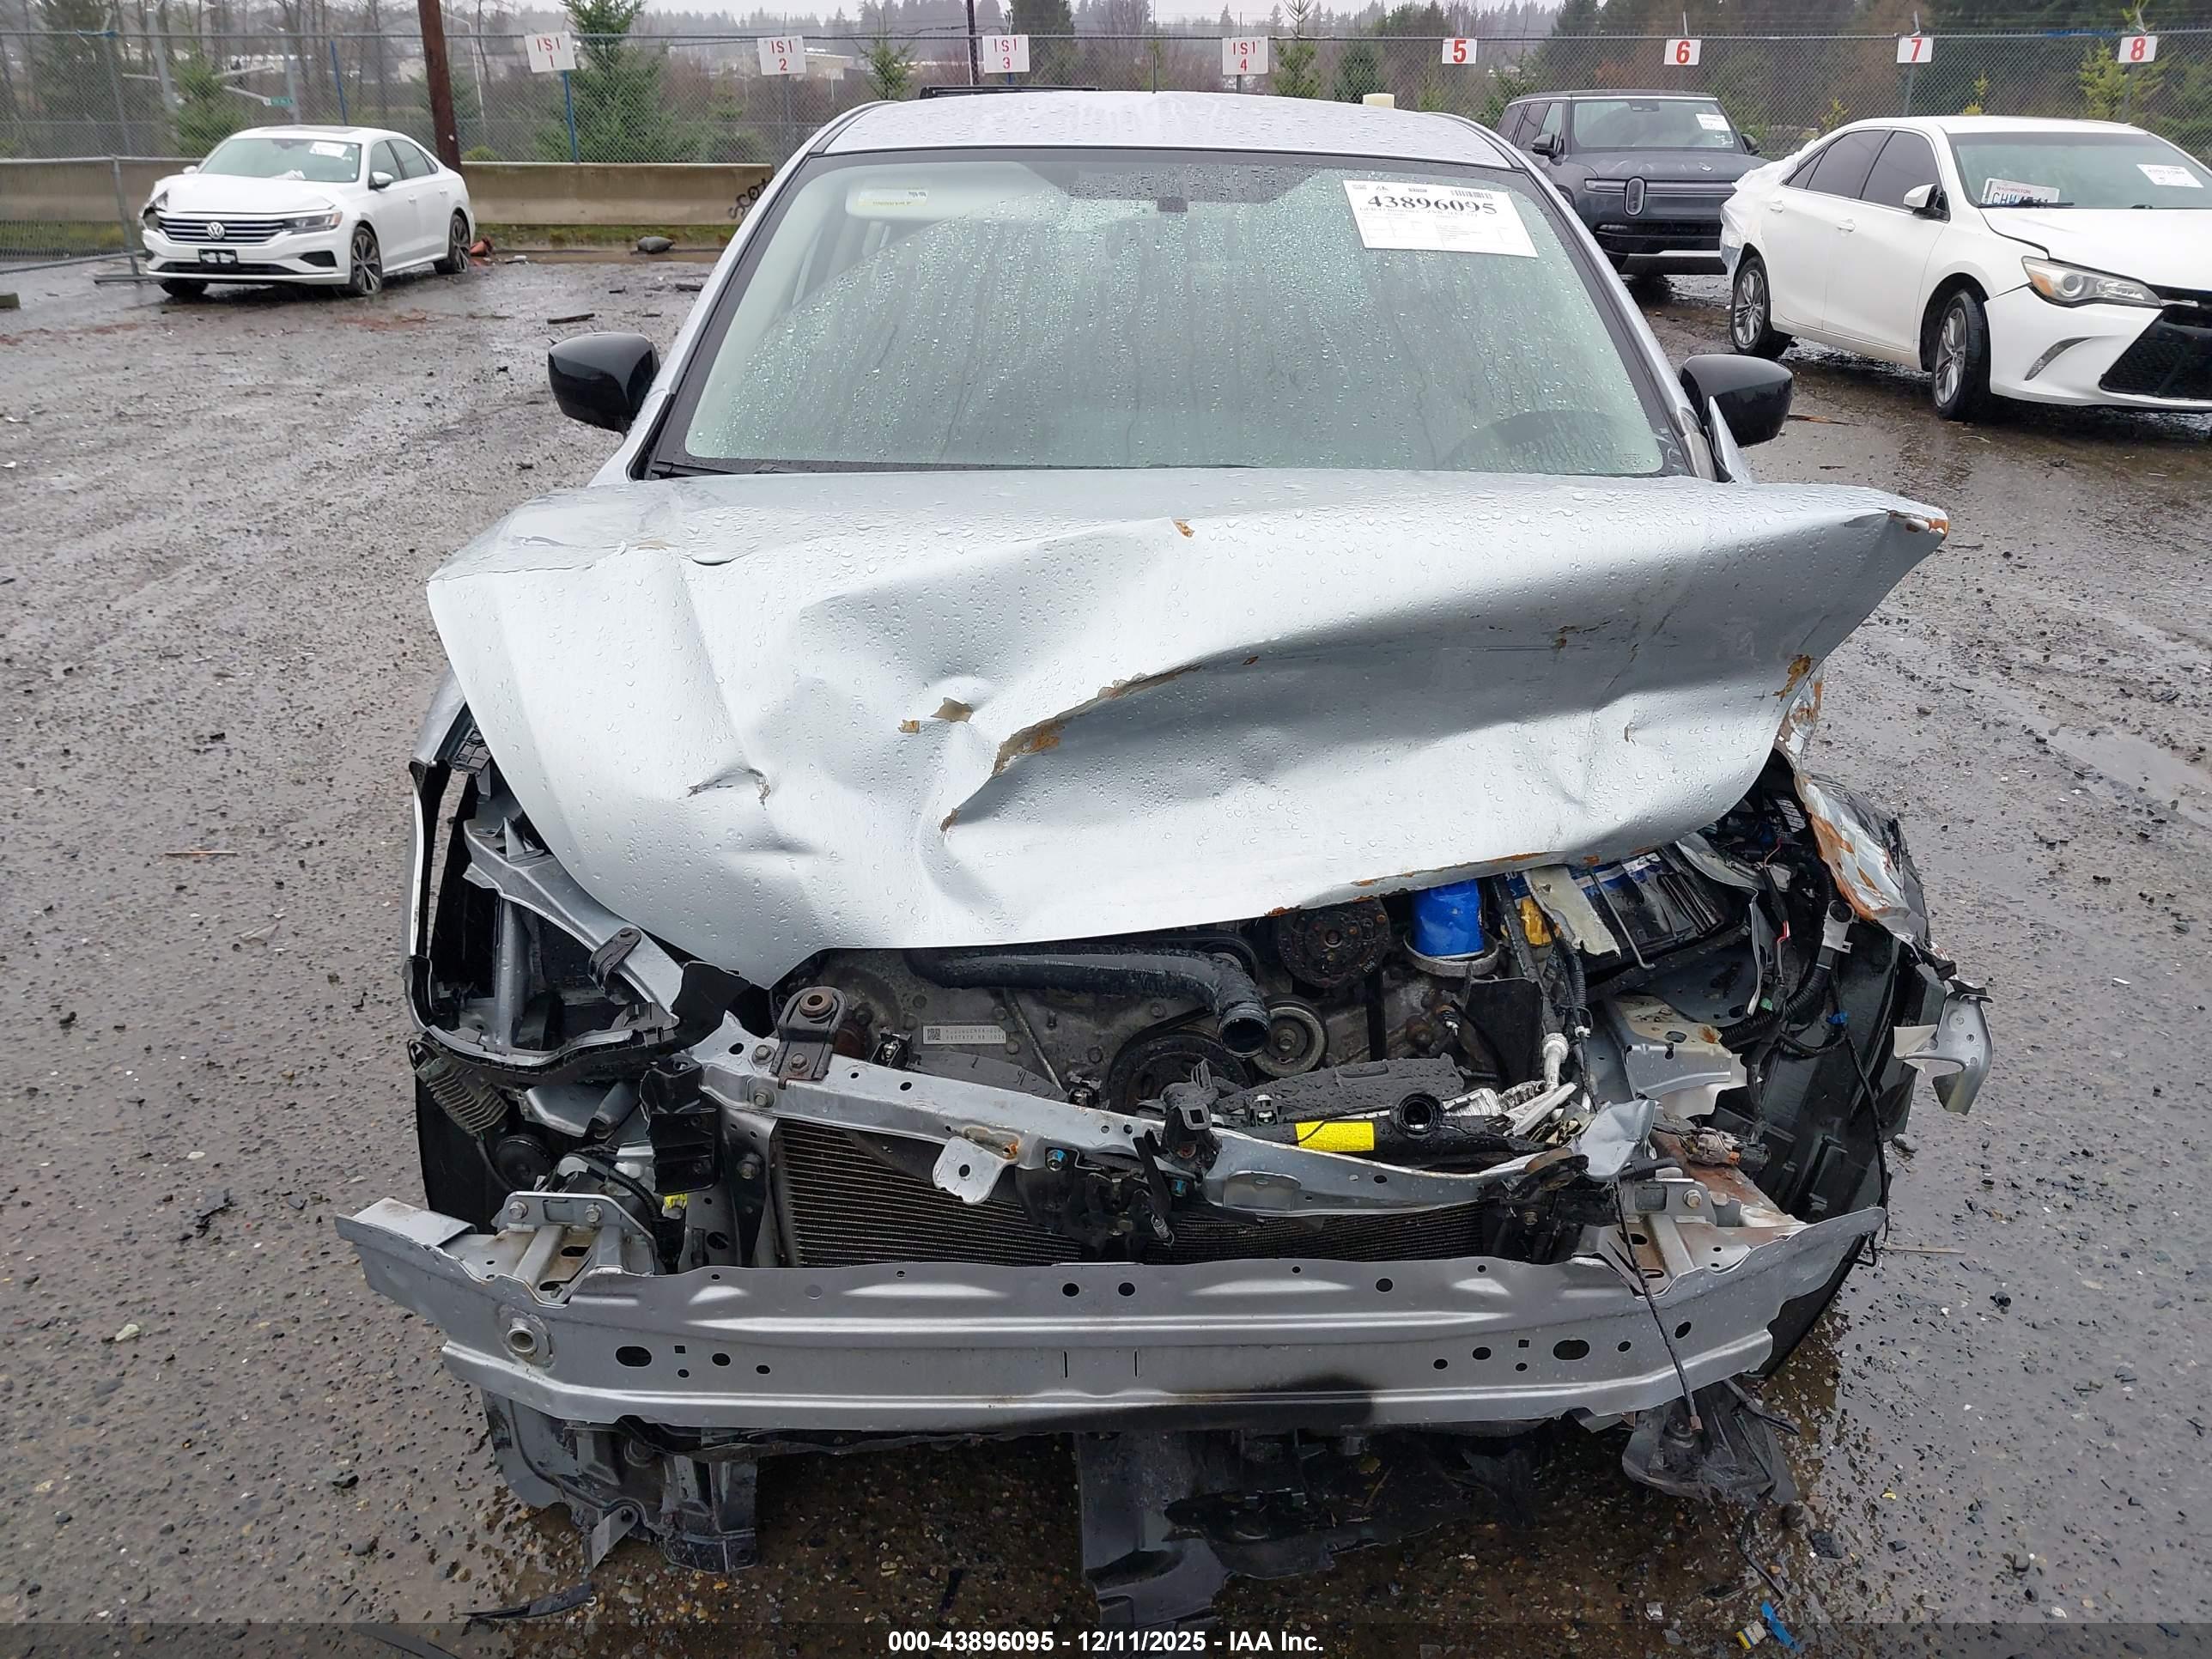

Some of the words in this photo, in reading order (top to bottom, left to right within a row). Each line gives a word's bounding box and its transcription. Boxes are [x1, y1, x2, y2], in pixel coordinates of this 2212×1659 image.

[1453, 40, 1467, 63] 5
[1676, 40, 1691, 64] 6
[1911, 39, 1923, 62] 7
[2130, 37, 2146, 61] 8
[778, 58, 788, 71] 2
[1002, 57, 1011, 70] 3
[1240, 58, 1248, 71] 4
[1367, 194, 1498, 215] 43896095
